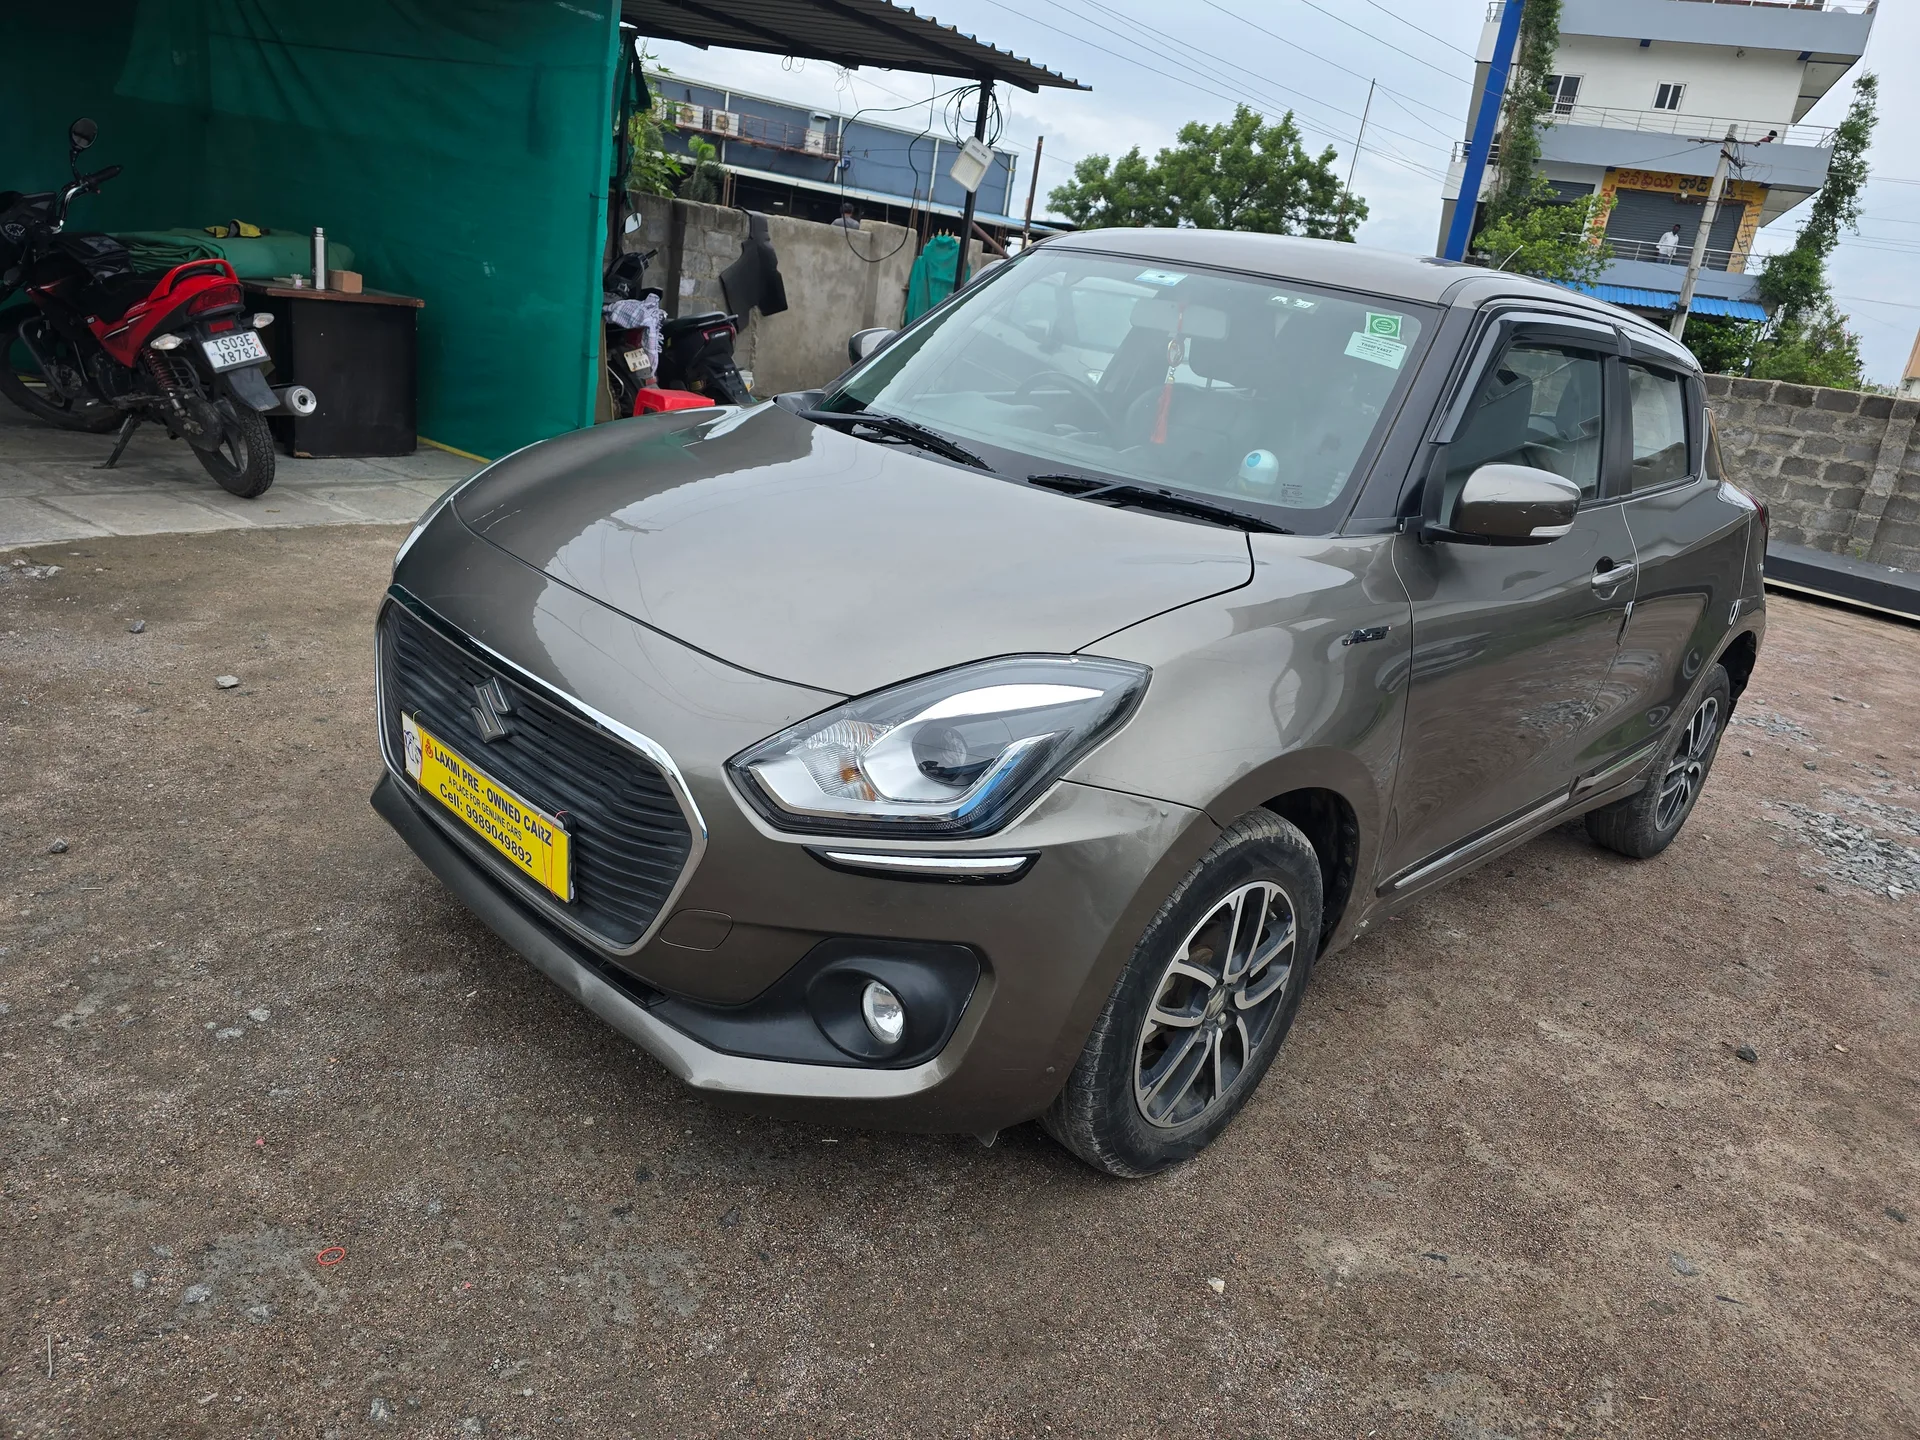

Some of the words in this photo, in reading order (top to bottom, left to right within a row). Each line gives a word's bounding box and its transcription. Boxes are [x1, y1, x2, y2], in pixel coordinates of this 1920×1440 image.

[213, 334, 254, 352] TS03E
[219, 346, 260, 365] X8782
[434, 746, 460, 778] LAXMI
[462, 768, 480, 793] PRE
[486, 787, 521, 824] OWNED
[523, 815, 553, 848] CARZ
[440, 783, 463, 812] Cell:
[465, 803, 533, 869] 9989049892
[452, 778, 470, 800] PLACE
[469, 792, 481, 810] FOR
[481, 802, 506, 829] GENUINE
[506, 821, 523, 842] CARS
